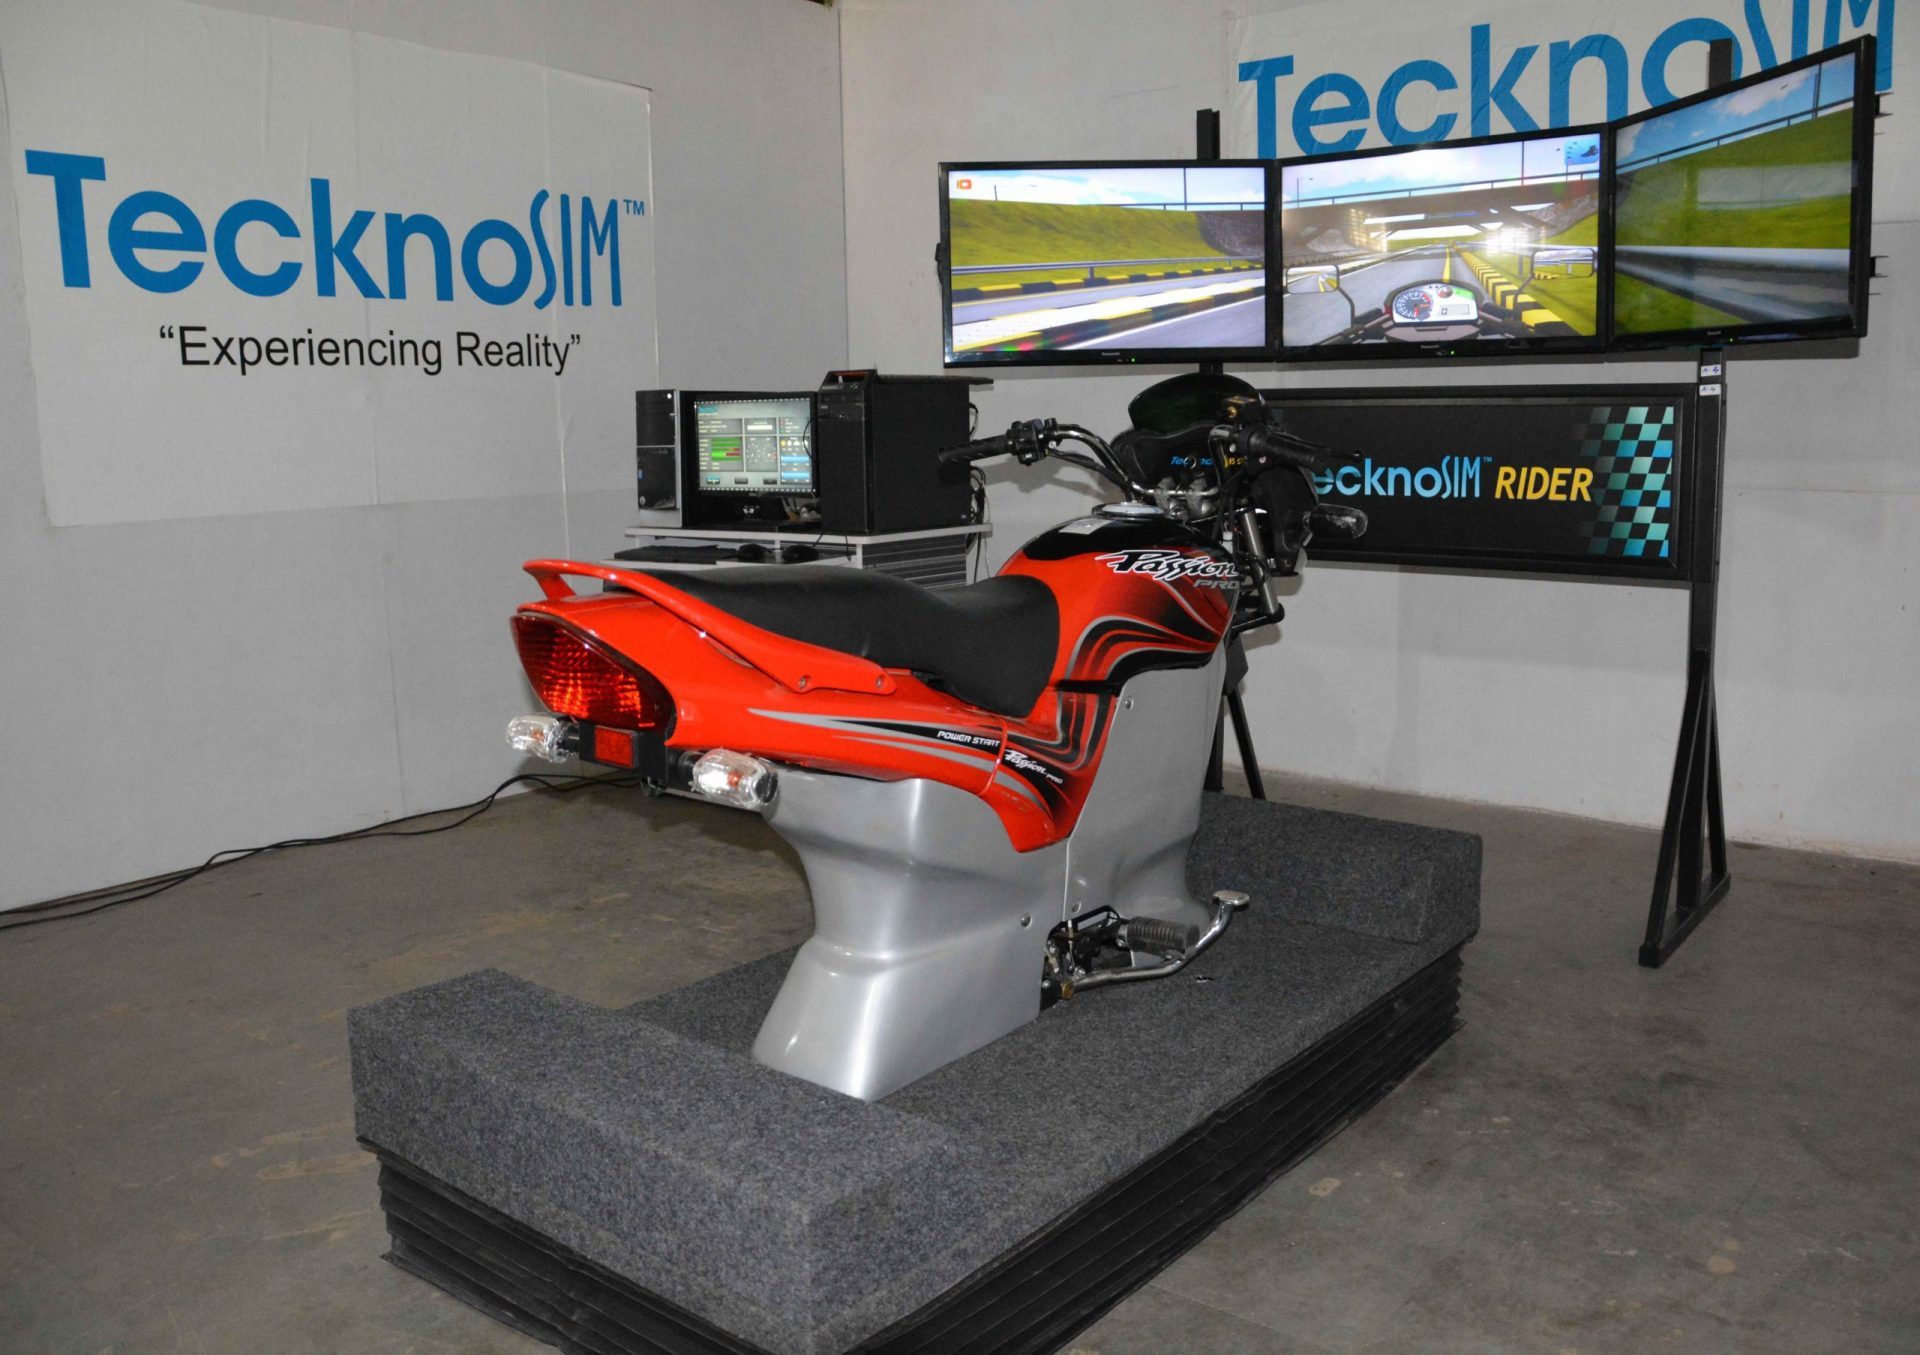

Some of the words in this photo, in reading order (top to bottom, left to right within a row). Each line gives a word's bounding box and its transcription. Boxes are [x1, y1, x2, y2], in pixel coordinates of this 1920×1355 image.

[25, 149, 622, 310] TecknoSIM
[159, 325, 441, 376] “Experiencing
[456, 331, 581, 376] Reality”
[1311, 455, 1481, 499] ecknoSIM
[1494, 466, 1594, 502] RIDER
[1095, 550, 1240, 581] Passion
[1193, 579, 1239, 590] PRO
[937, 730, 972, 743] POWER
[972, 736, 1001, 748] START
[1003, 748, 1046, 775] Passion
